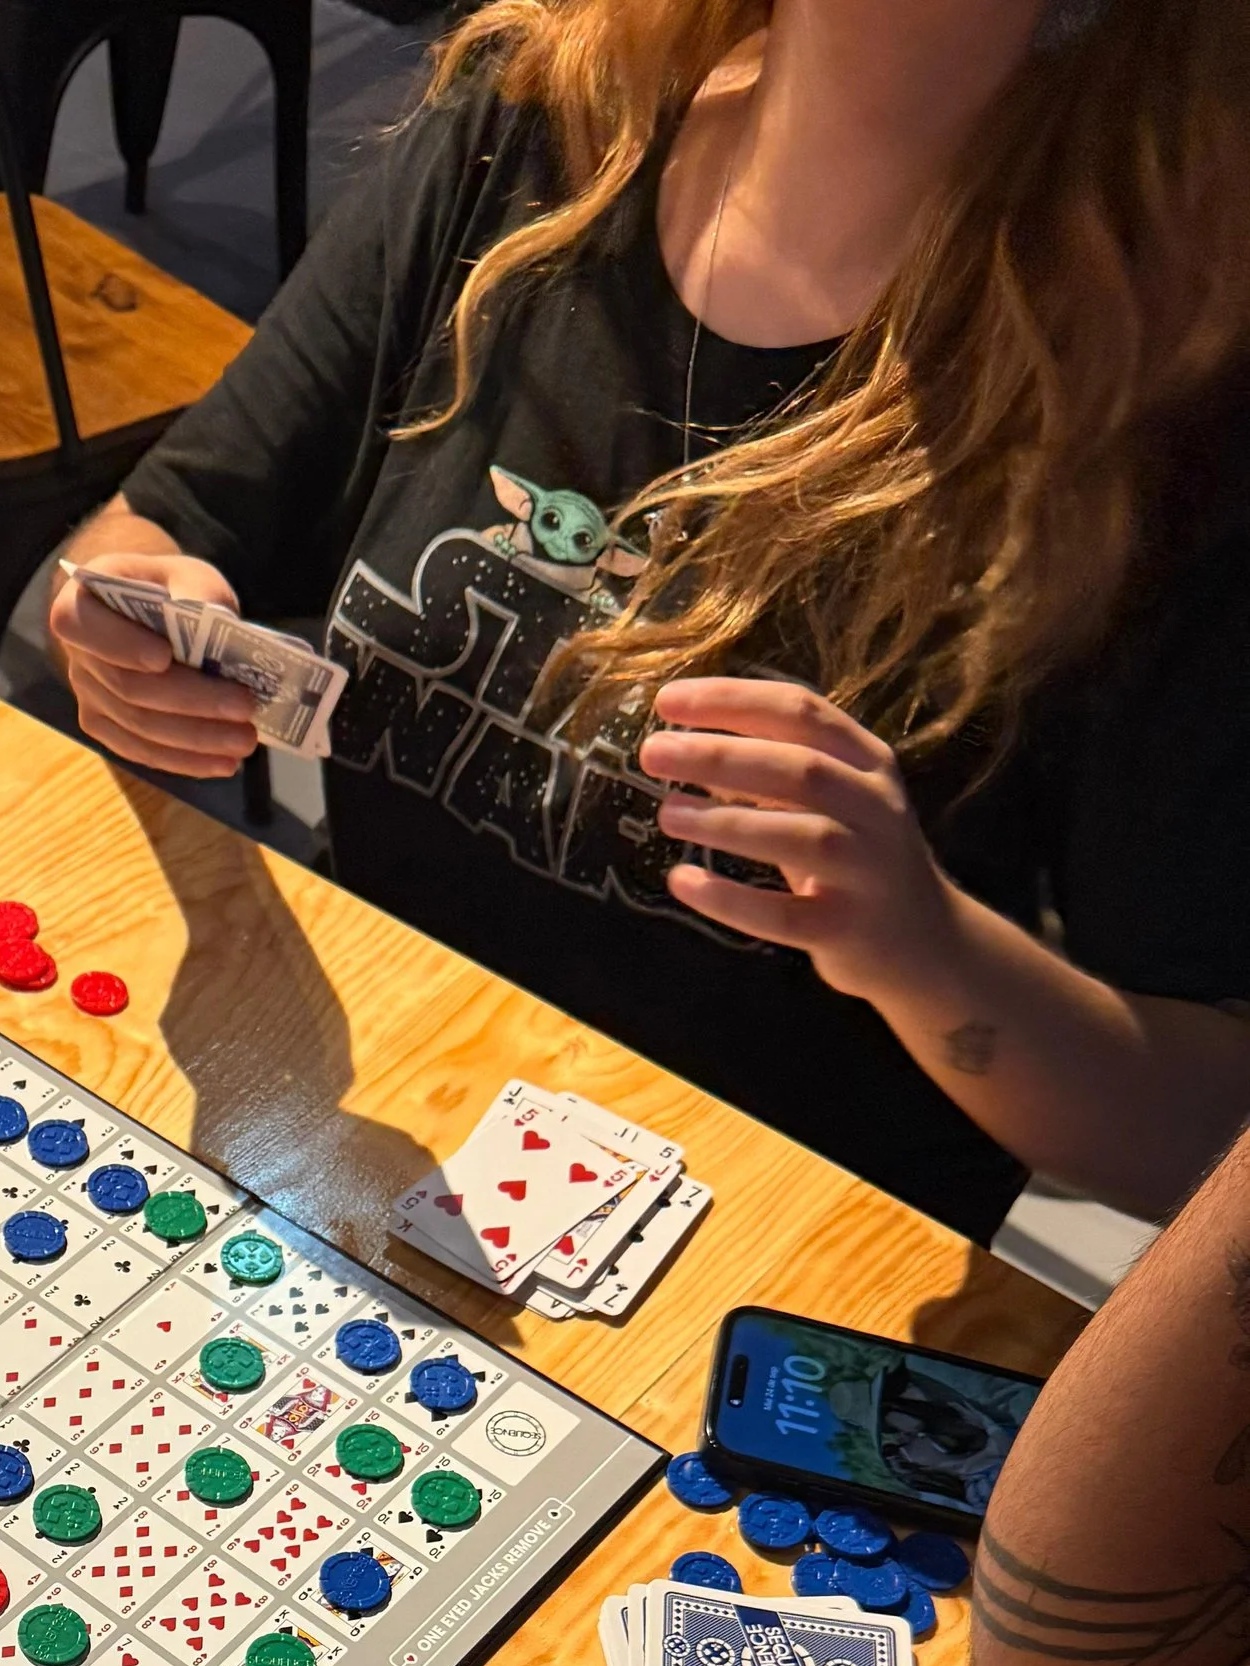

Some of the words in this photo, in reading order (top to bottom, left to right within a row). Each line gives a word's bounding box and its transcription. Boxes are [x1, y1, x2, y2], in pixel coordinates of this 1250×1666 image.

[509, 1087, 522, 1097] J
[523, 1108, 538, 1122] 5
[663, 1147, 675, 1158] 5
[610, 1169, 628, 1182] 5
[655, 1165, 670, 1176] J
[688, 1186, 702, 1198] 7
[401, 1197, 420, 1210] 5
[397, 1218, 414, 1232] K
[567, 1266, 583, 1279] J
[603, 1294, 619, 1308] 7
[775, 1355, 825, 1435] 11:10
[70, 1463, 80, 1471] 2
[438, 1456, 451, 1467] 10
[489, 1489, 502, 1500] 10
[118, 1497, 128, 1505] 2
[3, 1519, 14, 1528] 2
[378, 1513, 390, 1525] 10
[361, 1532, 371, 1541] Q
[52, 1554, 62, 1564] 2
[429, 1548, 442, 1559] 10
[413, 1566, 423, 1576] Q
[417, 1623, 448, 1652] ONE
[441, 1597, 472, 1629] EYED
[469, 1561, 510, 1601] JACKS
[502, 1518, 552, 1566] REMOVE
[298, 1591, 308, 1601] Q
[279, 1609, 290, 1619] K
[350, 1627, 360, 1637] Q
[122, 1638, 132, 1646] 7
[331, 1646, 342, 1656] K
